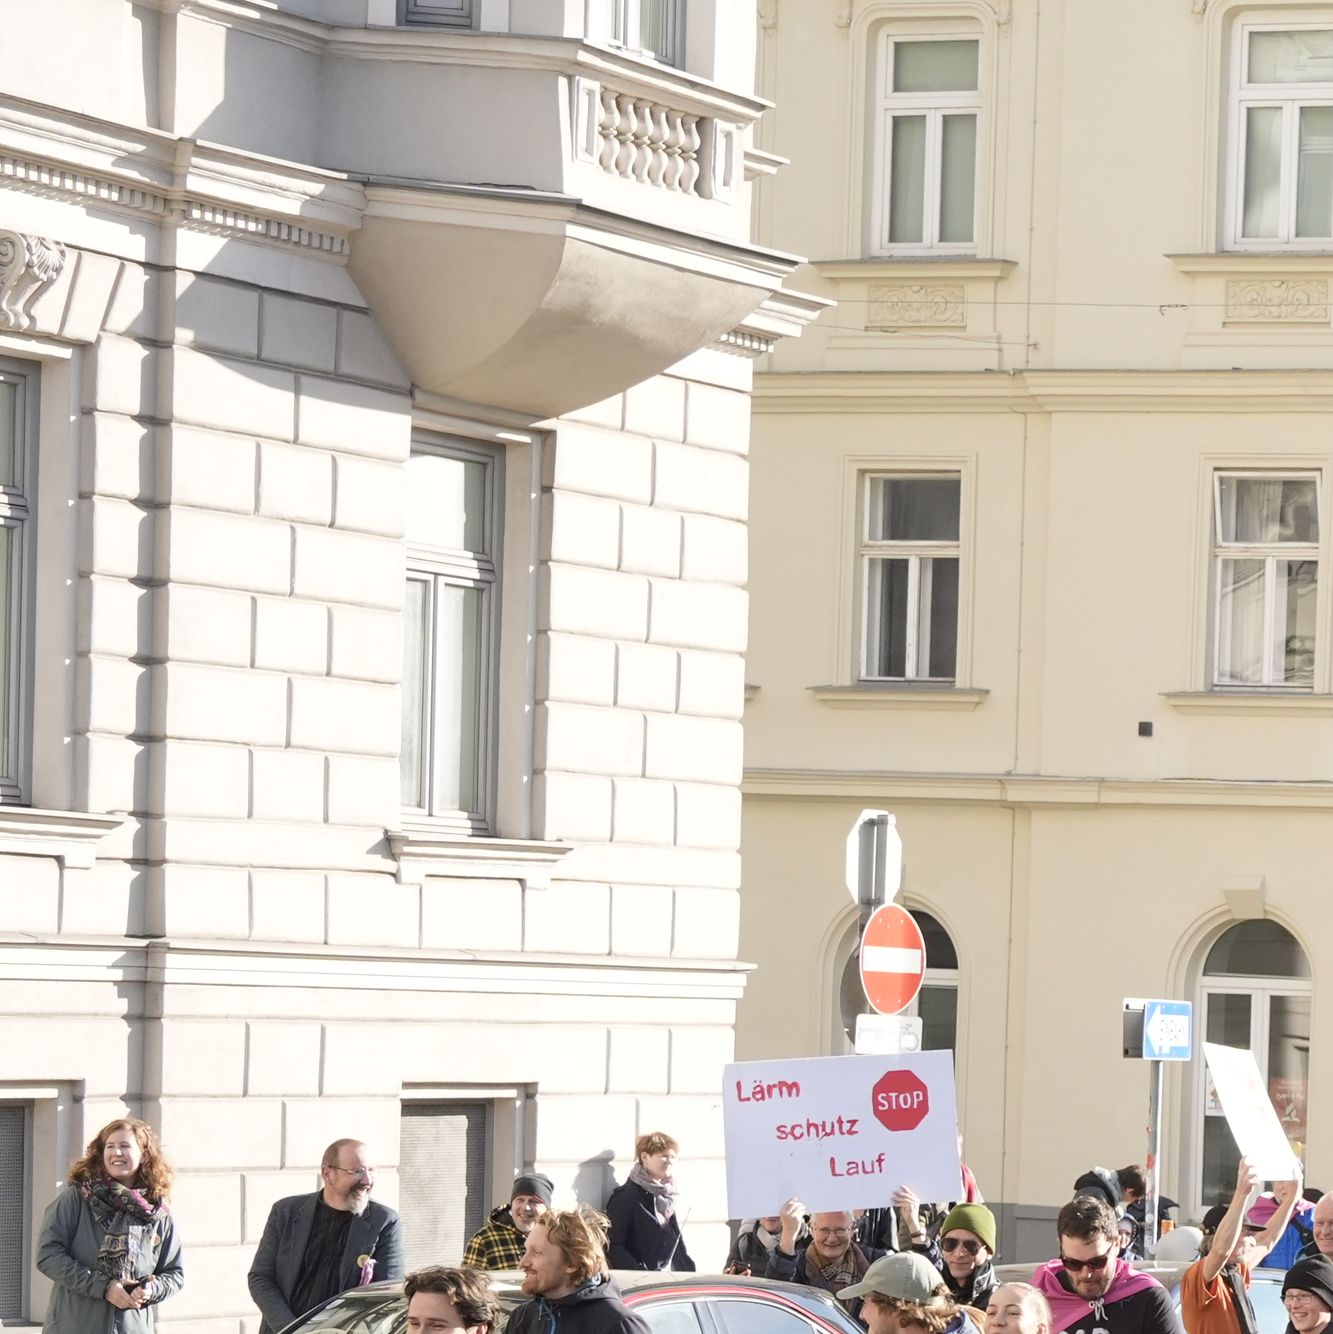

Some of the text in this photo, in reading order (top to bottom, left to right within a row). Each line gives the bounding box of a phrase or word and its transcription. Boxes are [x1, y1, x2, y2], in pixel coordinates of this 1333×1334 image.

[736, 1080, 800, 1102] Lärm
[878, 1091, 924, 1111] STOP
[776, 1115, 860, 1141] schutz
[829, 1152, 885, 1177] Lauf
